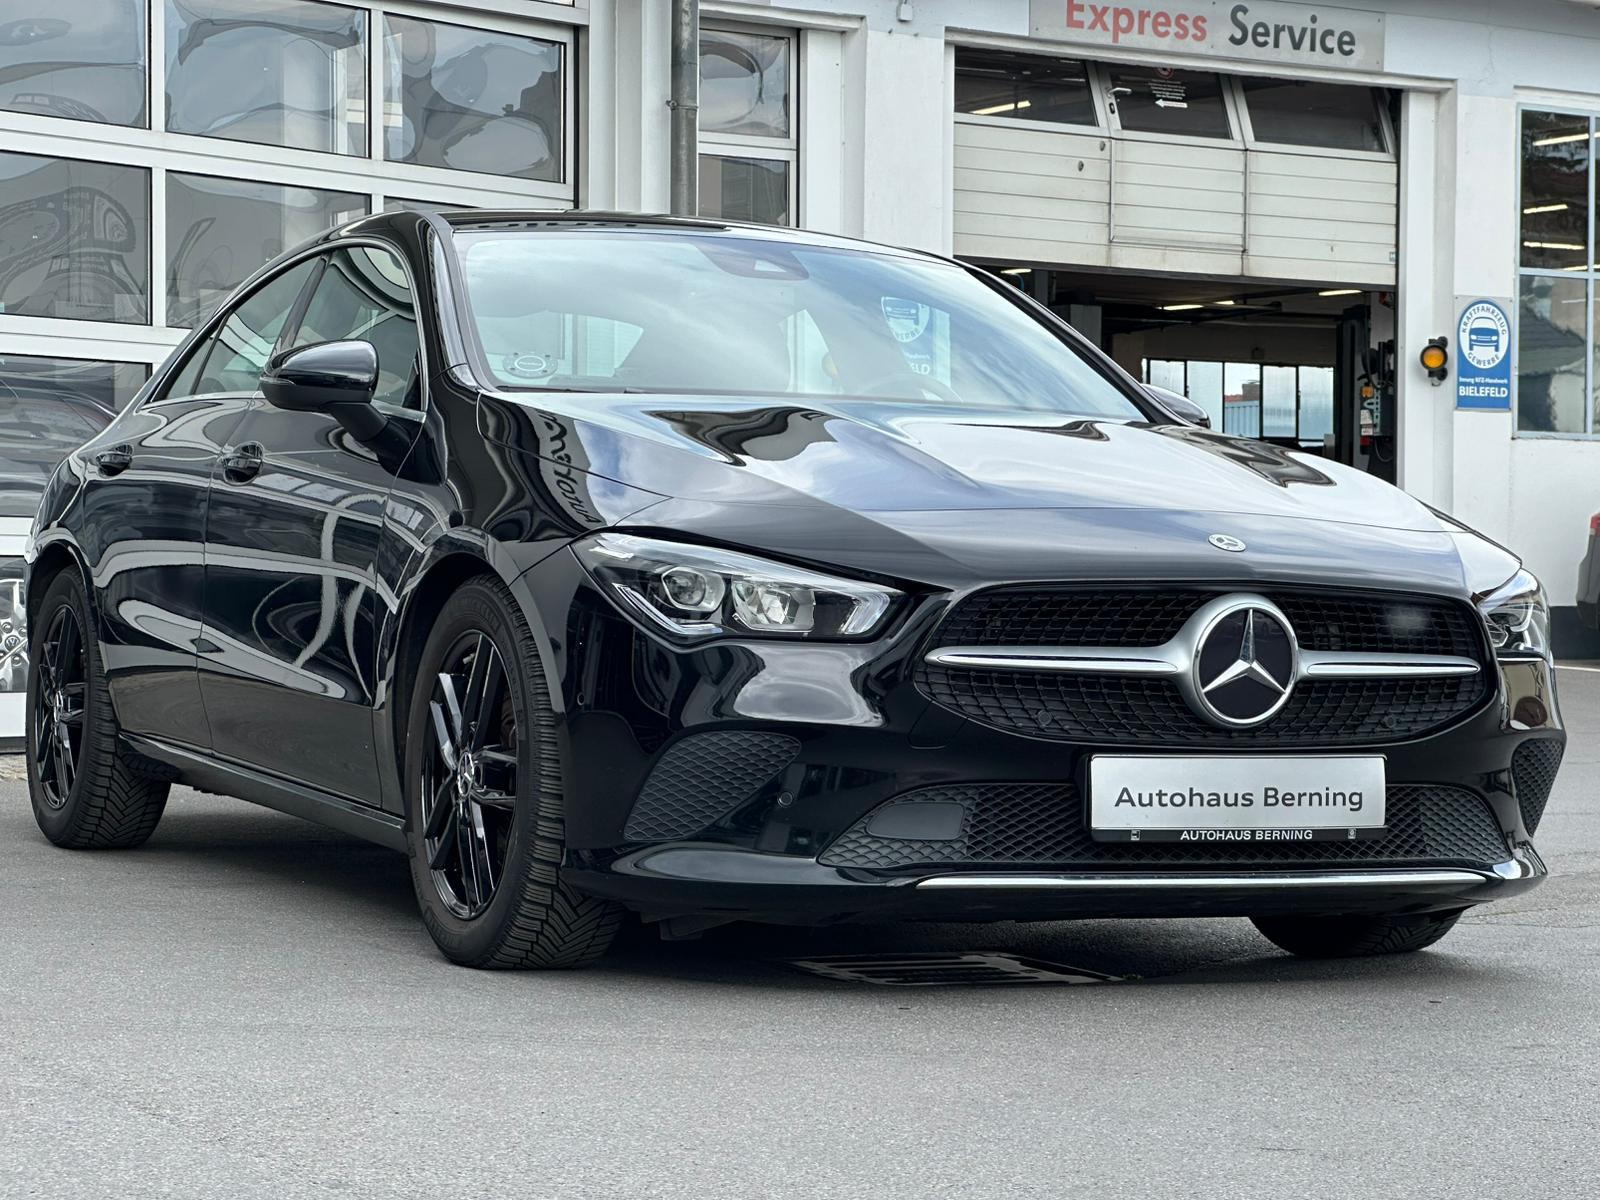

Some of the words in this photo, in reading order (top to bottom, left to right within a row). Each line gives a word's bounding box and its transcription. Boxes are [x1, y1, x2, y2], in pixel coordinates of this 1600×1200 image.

[1065, 0, 1208, 43] Express
[1228, 5, 1357, 57] Service
[1462, 305, 1507, 335] KRAFTFAHRZEUG
[1468, 352, 1499, 366] GEWERBE
[1459, 386, 1508, 398] BIELEFELD
[1114, 787, 1254, 808] Autohaus
[1263, 787, 1364, 812] Berning
[1180, 830, 1251, 841] AUTOHAUS
[1255, 829, 1313, 840] BERNING
